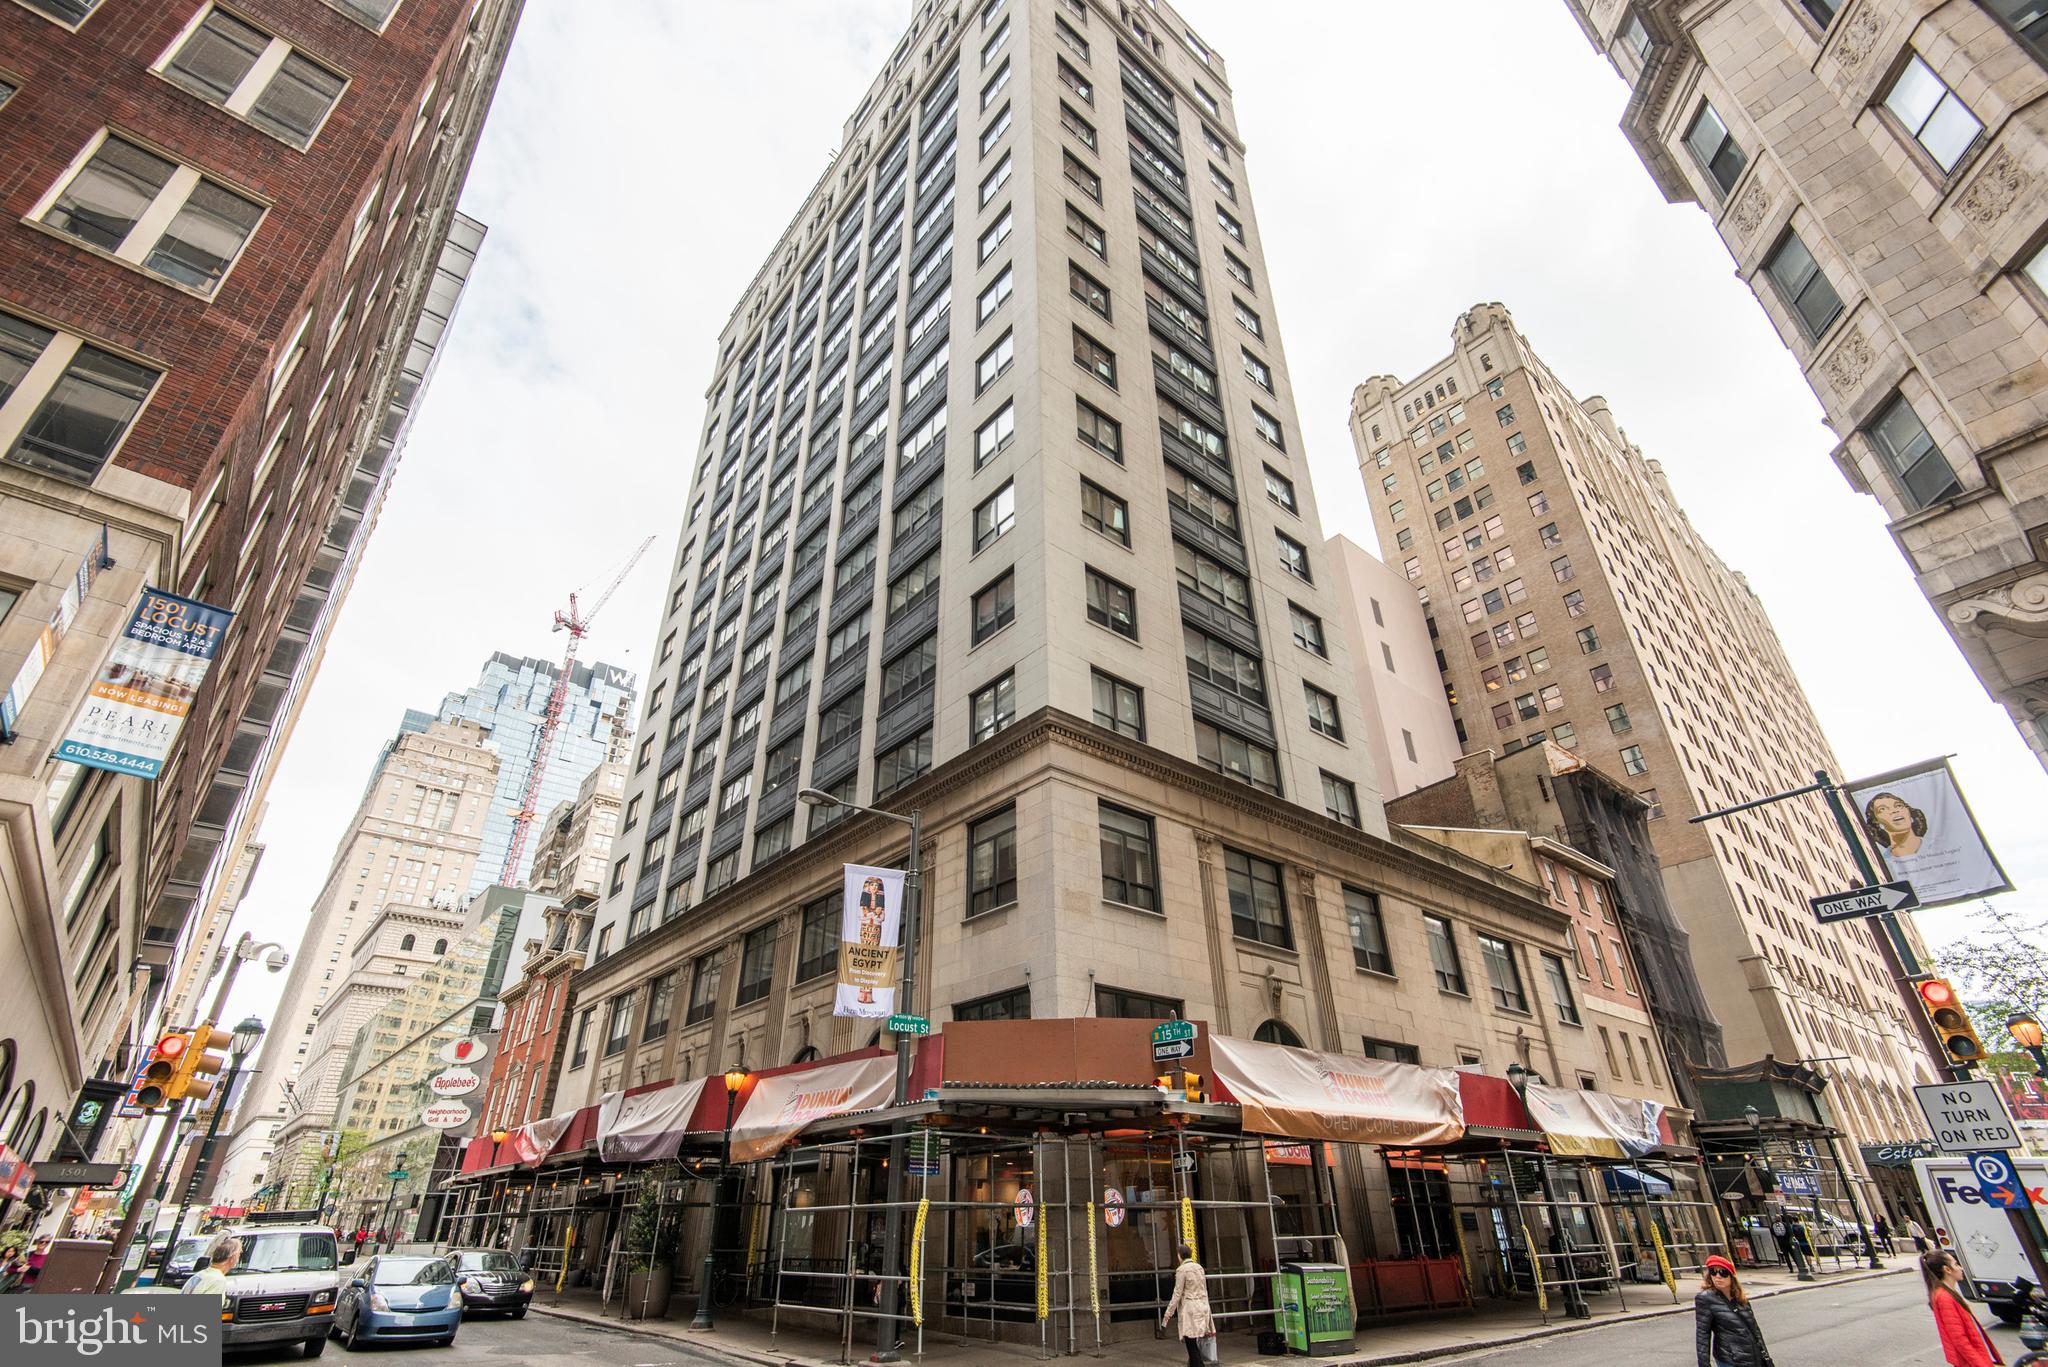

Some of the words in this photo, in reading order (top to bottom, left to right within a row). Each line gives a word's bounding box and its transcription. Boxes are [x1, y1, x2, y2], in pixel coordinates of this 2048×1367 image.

[148, 596, 187, 615] 1501
[140, 609, 221, 638] LOCUST
[130, 627, 181, 647] BEDROOM
[182, 641, 208, 654] APTS
[134, 621, 182, 638] SPACIOUS
[190, 635, 197, 643] 2
[197, 637, 206, 646] &
[206, 640, 213, 648] 3
[98, 686, 127, 699] NOW
[130, 693, 183, 712] LEASING!
[65, 745, 154, 772] 610.529.4444
[1823, 900, 1854, 914] ONE
[1855, 894, 1882, 908] WAY
[848, 946, 890, 959] ANCIENT
[852, 958, 883, 969] EGYPT
[889, 1020, 918, 1033] Locust
[920, 1023, 929, 1034] St
[1184, 1029, 1191, 1037] ST
[1157, 1046, 1169, 1056] ONE
[1170, 1045, 1182, 1053] WAY
[434, 1076, 477, 1089] Applebee's
[800, 1086, 853, 1110] DUNKIN'
[1941, 1091, 1972, 1105] NO
[427, 1108, 468, 1116] Neighborhood
[1941, 1108, 1991, 1124] TURN
[1365, 1118, 1400, 1135] COME
[1941, 1129, 1967, 1143] ON
[1972, 1127, 2010, 1142] RED
[1877, 1146, 1924, 1160] Estia
[60, 1168, 88, 1177] 1501
